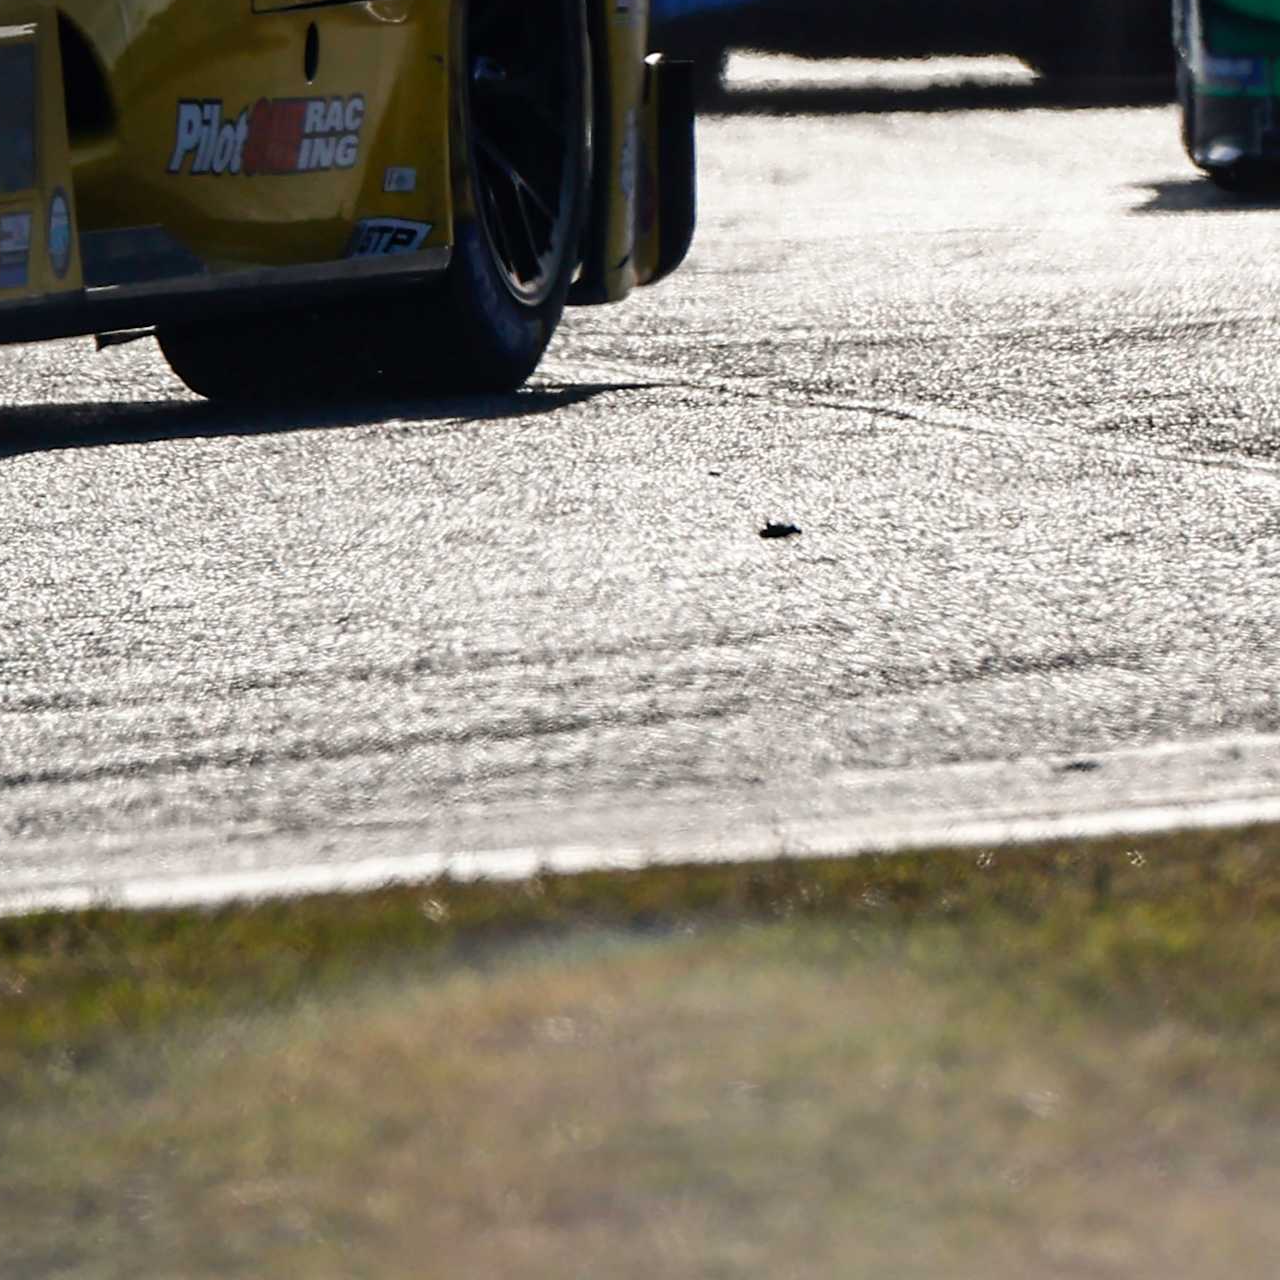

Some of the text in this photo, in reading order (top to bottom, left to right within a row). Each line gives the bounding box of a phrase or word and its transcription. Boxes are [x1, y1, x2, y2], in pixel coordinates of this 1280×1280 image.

[305, 97, 364, 133] RAC
[169, 102, 248, 172] Pilot
[298, 136, 359, 169] ING
